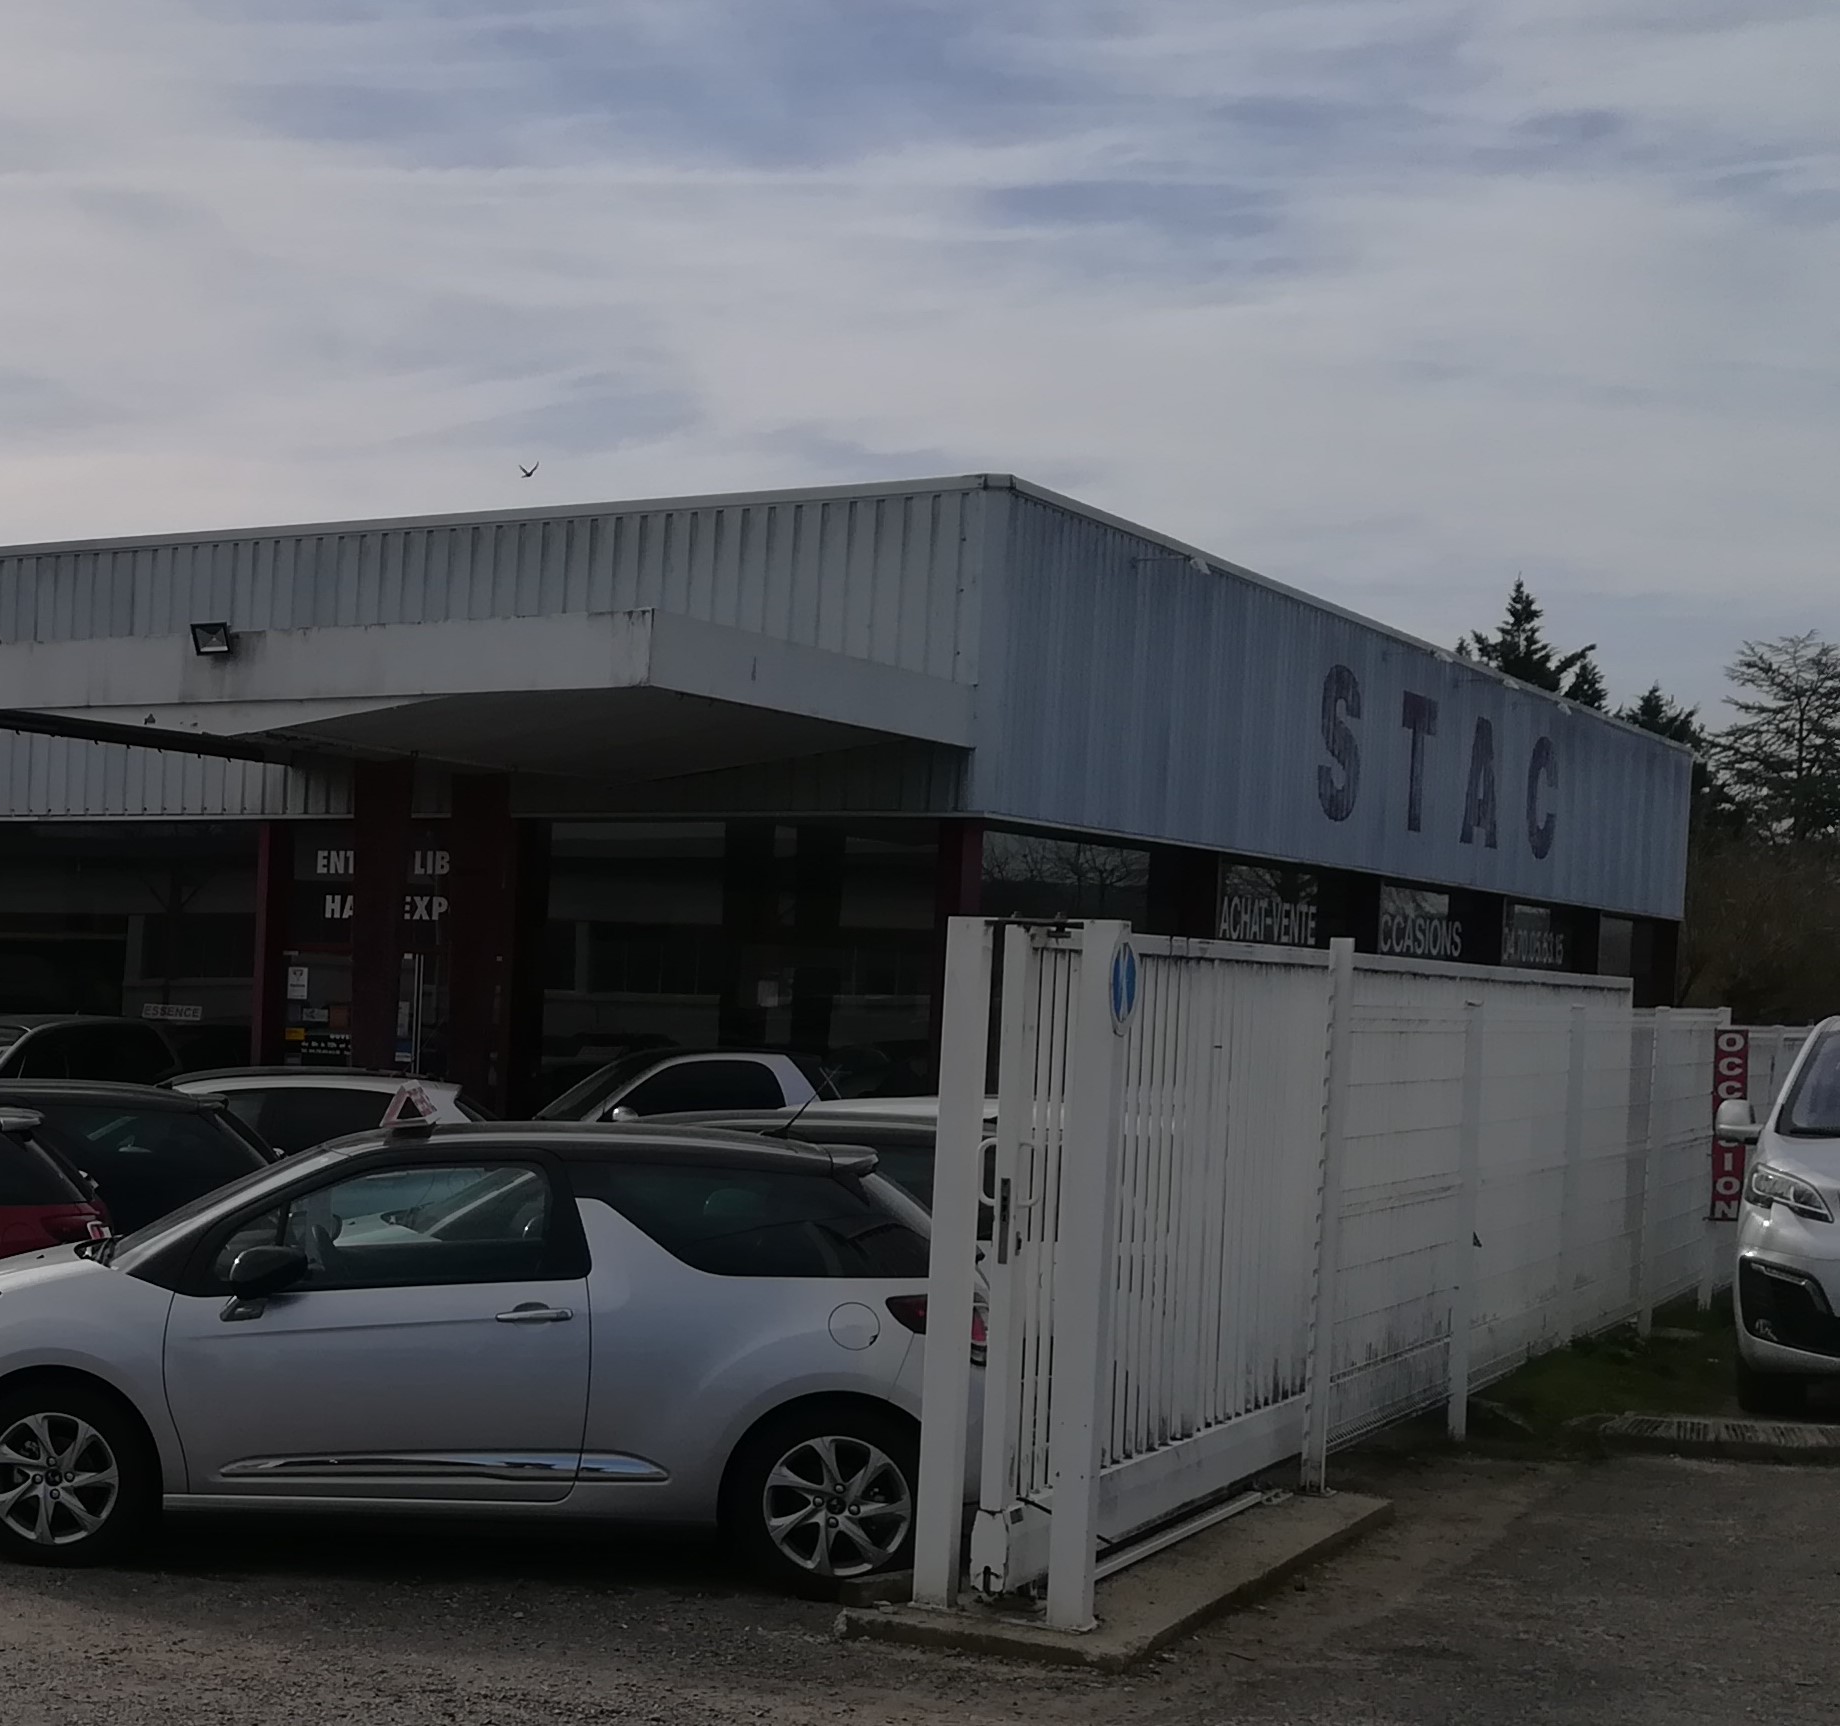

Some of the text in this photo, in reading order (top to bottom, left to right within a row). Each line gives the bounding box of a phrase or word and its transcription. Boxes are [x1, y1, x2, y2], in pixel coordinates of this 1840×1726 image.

[1317, 664, 1558, 860] STAC
[316, 850, 451, 875] ENT LIB
[324, 894, 450, 920] HA EXP
[1218, 896, 1317, 945] ACHAT-VENTE
[1380, 914, 1463, 958] CCASIONS
[144, 1005, 200, 1018] ESSENCE
[1714, 1032, 1746, 1219] OCCION
